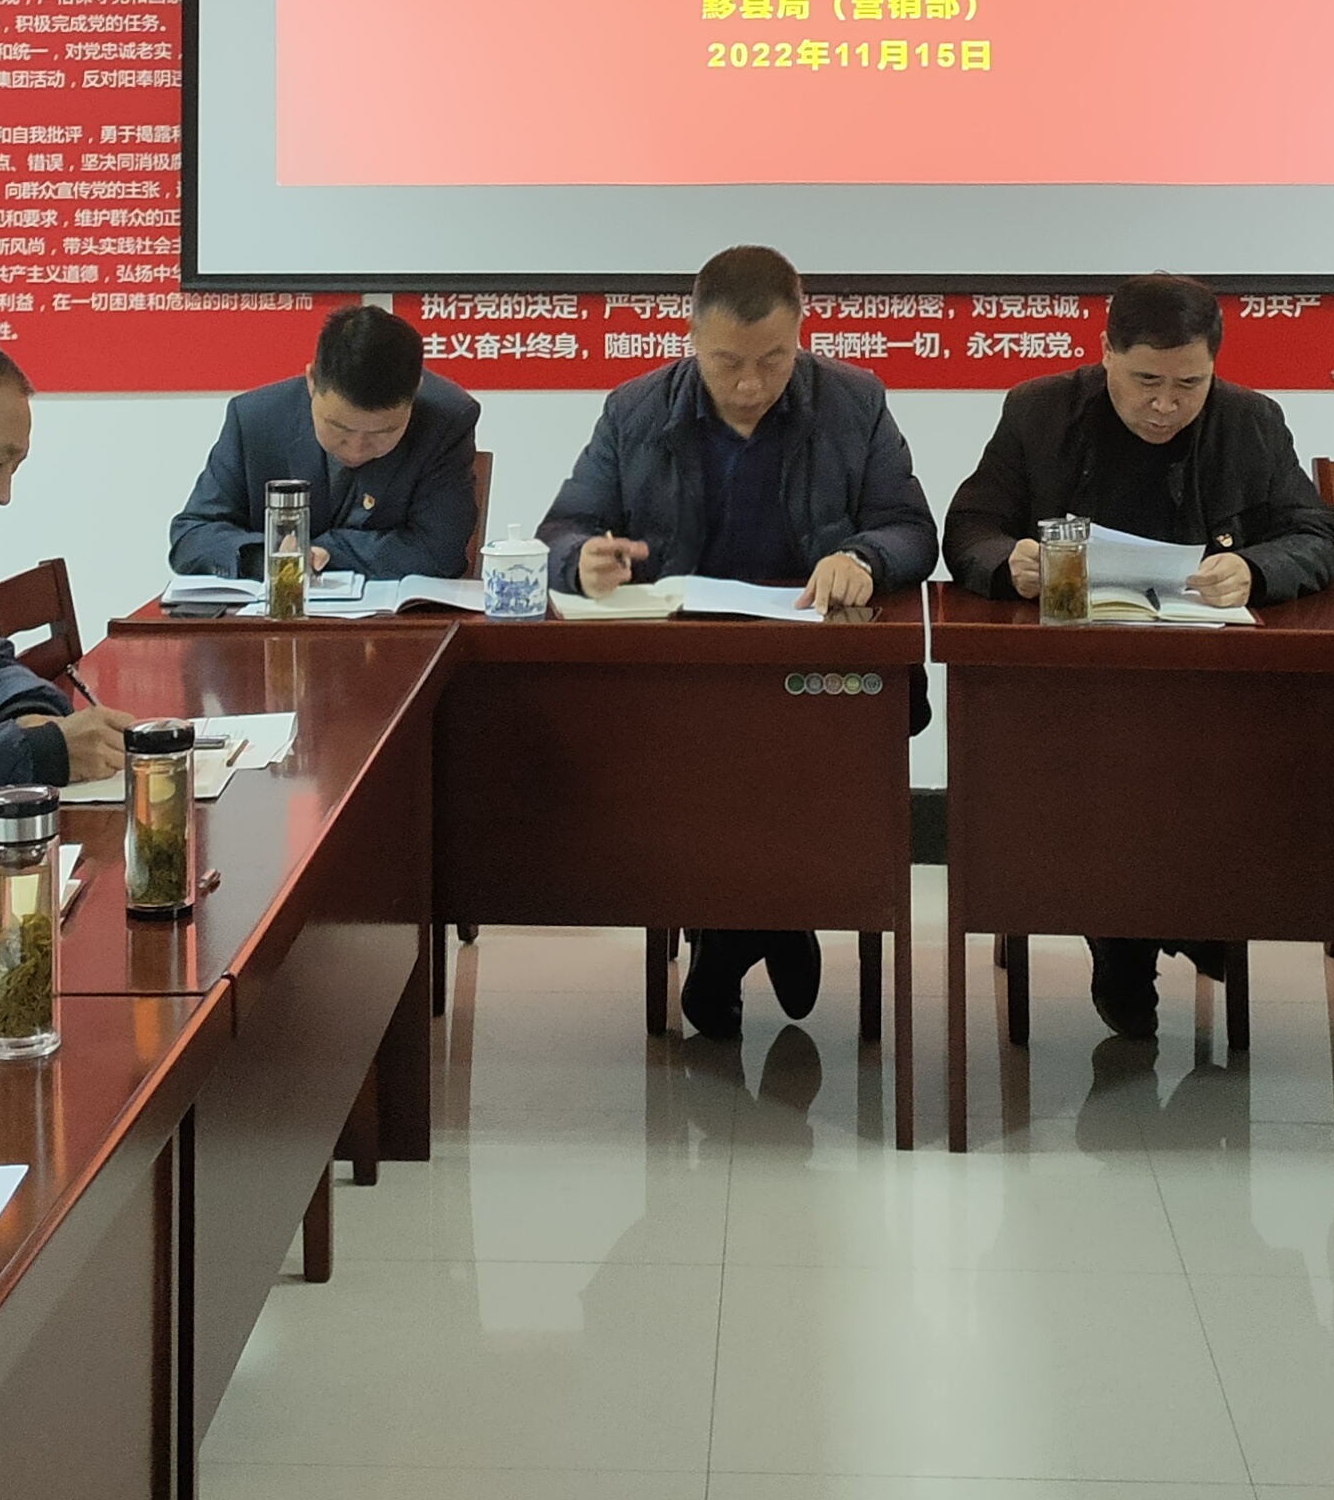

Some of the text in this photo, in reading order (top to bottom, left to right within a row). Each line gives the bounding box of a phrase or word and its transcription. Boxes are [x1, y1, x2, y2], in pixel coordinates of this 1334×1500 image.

[707, 39, 991, 71] 2022年11月15日
[801, 295, 1113, 319] 守党的秘密，对党忠诚，
[798, 332, 1086, 359] 民牺牲一切，永不叛党。
